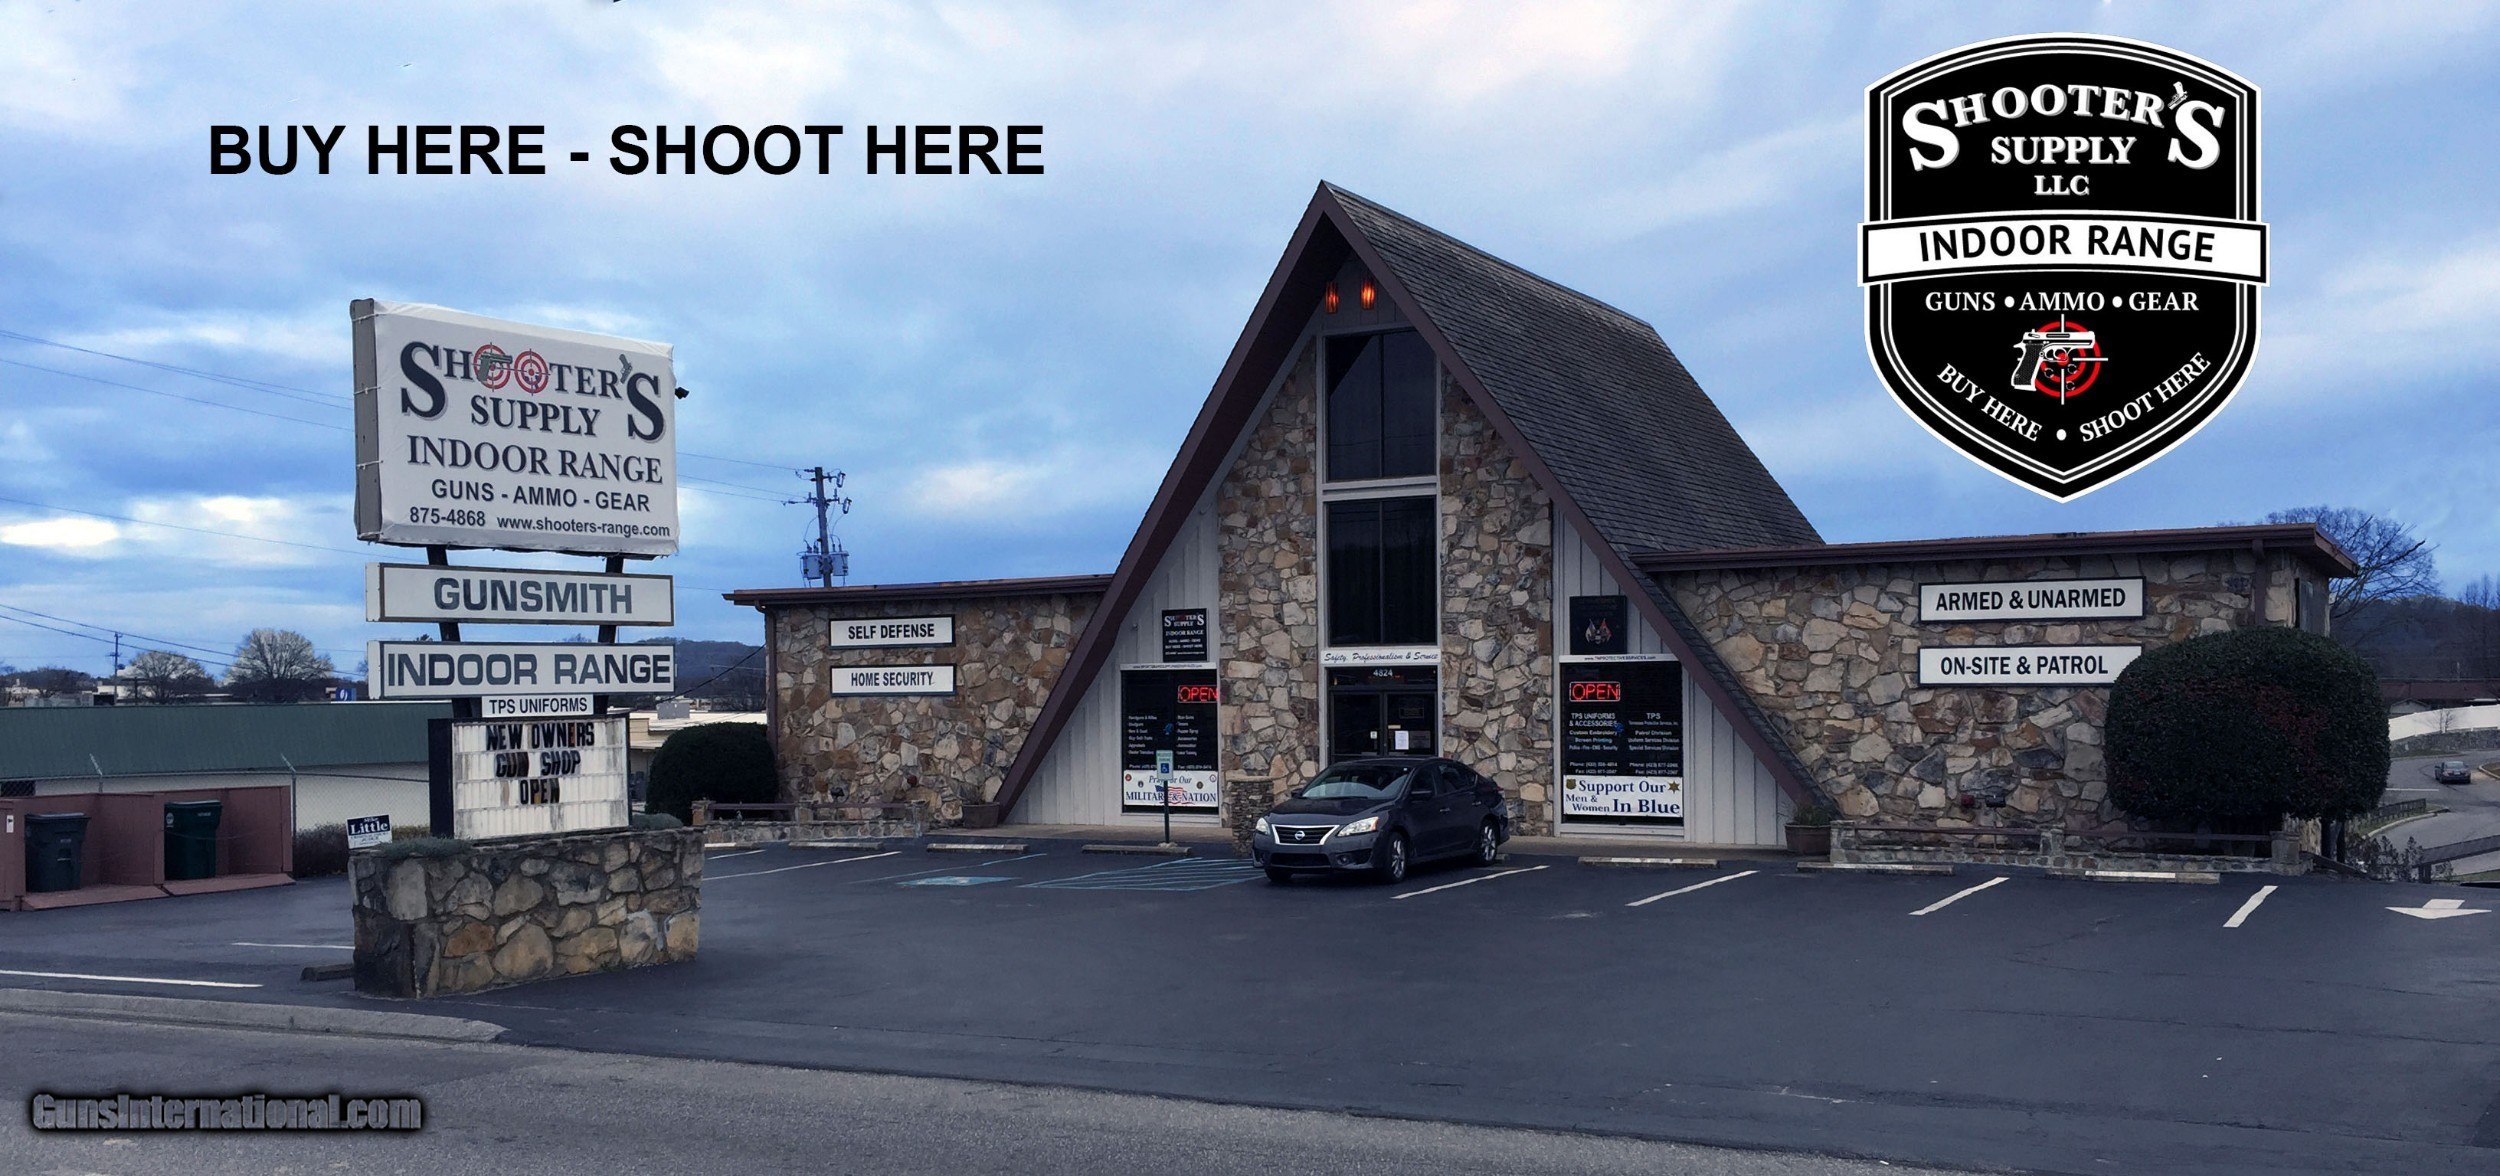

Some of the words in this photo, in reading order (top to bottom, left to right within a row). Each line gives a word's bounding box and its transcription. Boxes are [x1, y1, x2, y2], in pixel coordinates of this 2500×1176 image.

[471, 395, 601, 437] SUPPLY
[407, 435, 551, 477] INDOOR
[559, 449, 662, 485] RANGE
[431, 479, 495, 502] GUNS
[513, 485, 577, 507] AMMO
[595, 491, 651, 512] GEAR
[409, 506, 486, 527] 875-4868
[497, 515, 670, 537] www.shooters-range.com
[433, 577, 632, 614] GUNSMITH
[1936, 591, 2003, 611] ARMED
[2008, 590, 2024, 610] &
[2028, 587, 2126, 609] UNARMED
[848, 625, 877, 640] SELF
[880, 623, 935, 638] DEFENSE
[388, 653, 538, 687] INDOOR
[554, 653, 671, 685] RANGE
[1941, 656, 2011, 675] ON-SITE
[2016, 656, 2031, 675] &
[2037, 655, 2108, 675] PATROL
[851, 672, 879, 687] HOME
[883, 671, 934, 686] SECURITY
[1180, 686, 1219, 702] OPEN
[1572, 683, 1620, 701] OPEN
[489, 699, 516, 715] TPS
[520, 697, 588, 713] UNIFORMS
[1571, 712, 1583, 720] TPS
[1584, 712, 1616, 720] UNIFORMS
[1646, 712, 1661, 720] TPS
[486, 724, 523, 751] NEW
[531, 722, 595, 750] OWNERS
[495, 751, 529, 778] GUN
[541, 750, 581, 776] SHOP
[1180, 775, 1193, 784] Our
[1579, 779, 1634, 795] Support
[1639, 780, 1666, 793] Our
[519, 777, 560, 805] OPEN
[1126, 791, 1171, 801] MILITAR
[1182, 793, 1217, 802] NATION
[1565, 793, 1587, 803] Men
[1590, 795, 1598, 803] &
[1572, 803, 1610, 812] Women
[1613, 798, 1632, 813] In
[1637, 799, 1680, 814] Blue
[350, 820, 389, 835] Little
